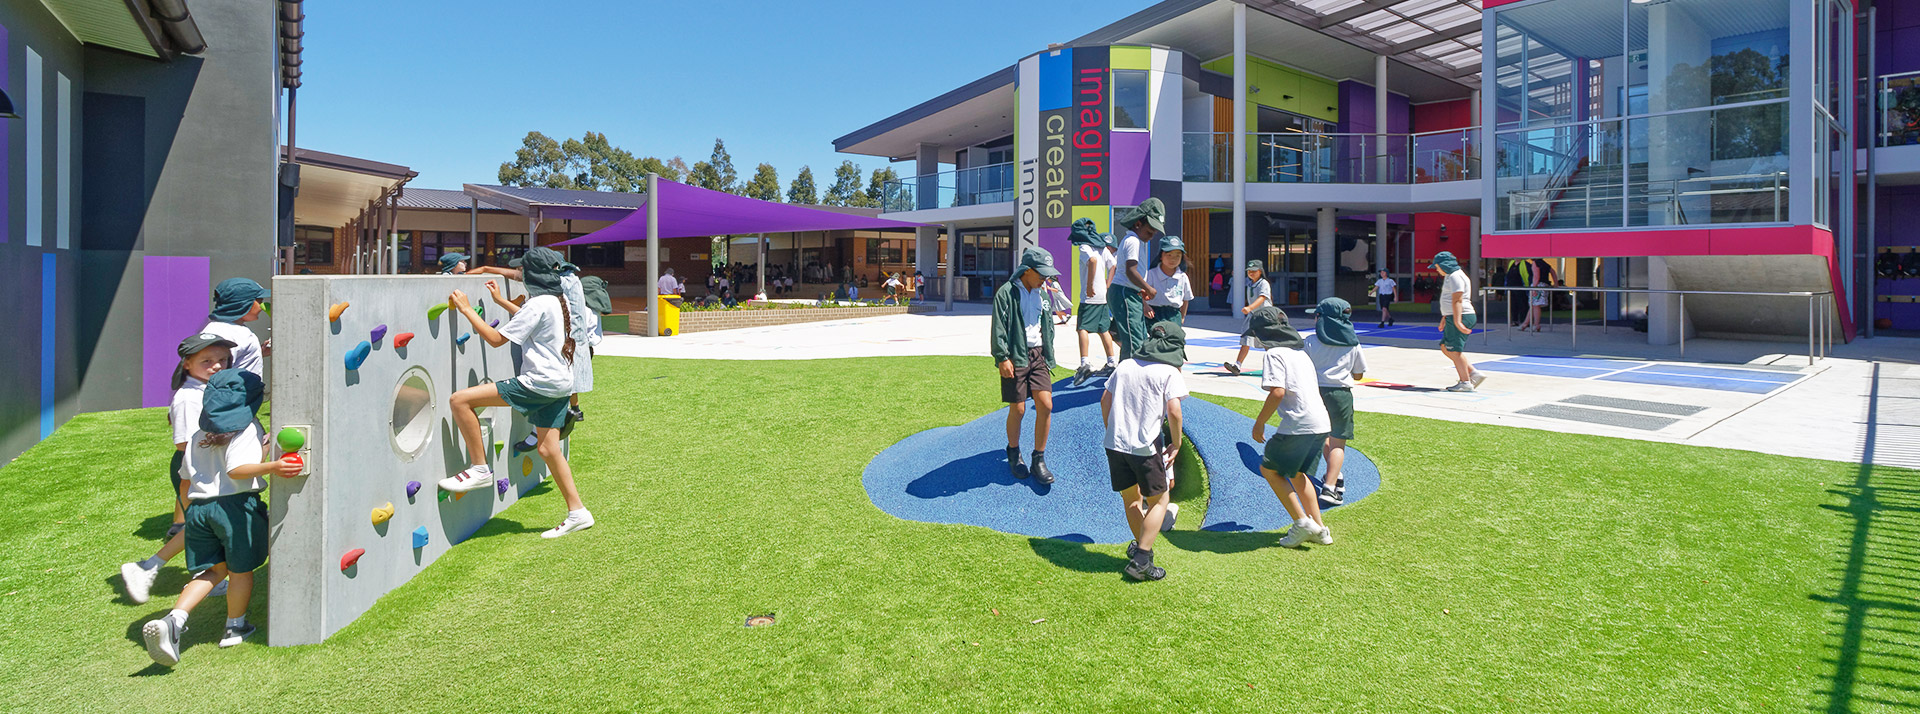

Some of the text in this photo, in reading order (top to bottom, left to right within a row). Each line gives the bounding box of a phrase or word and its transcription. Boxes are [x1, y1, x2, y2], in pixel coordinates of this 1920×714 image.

[1046, 114, 1070, 219] create
[1073, 67, 1109, 201] imagine
[1022, 158, 1038, 254] innov
